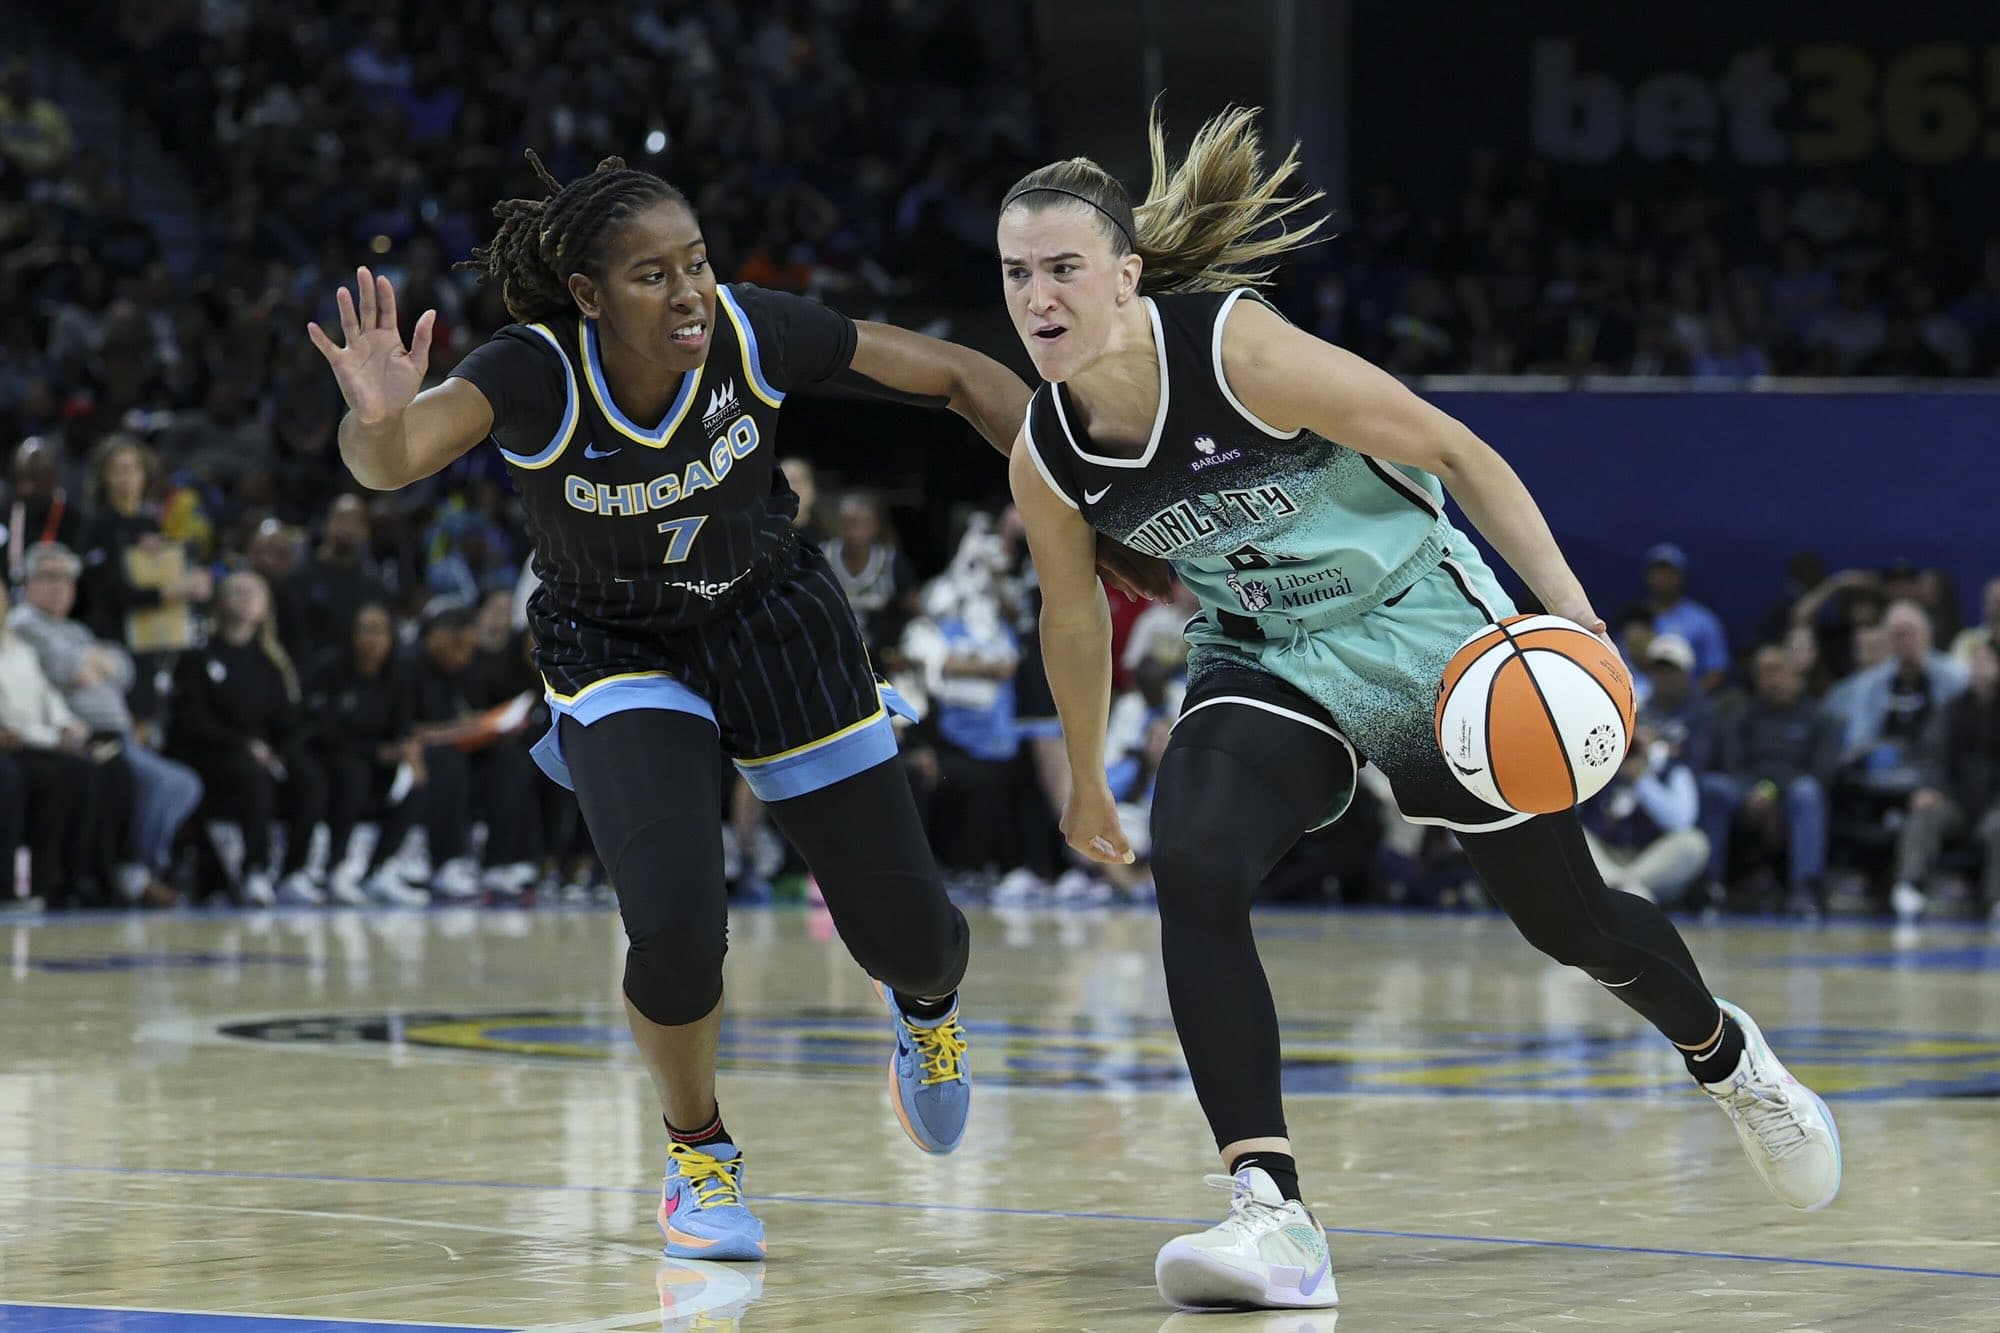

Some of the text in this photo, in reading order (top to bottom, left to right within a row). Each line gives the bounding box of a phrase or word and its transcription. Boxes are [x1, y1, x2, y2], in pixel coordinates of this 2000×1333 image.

[1532, 37, 2000, 165] bet36
[703, 400, 740, 430] MAGELLAN
[565, 414, 760, 516] CHICAGO
[1191, 448, 1241, 472] BARCLAYS
[657, 515, 709, 564] 7
[1123, 483, 1299, 560] QUALITY
[1275, 567, 1343, 592] Liberty
[1281, 577, 1353, 610] Mutual
